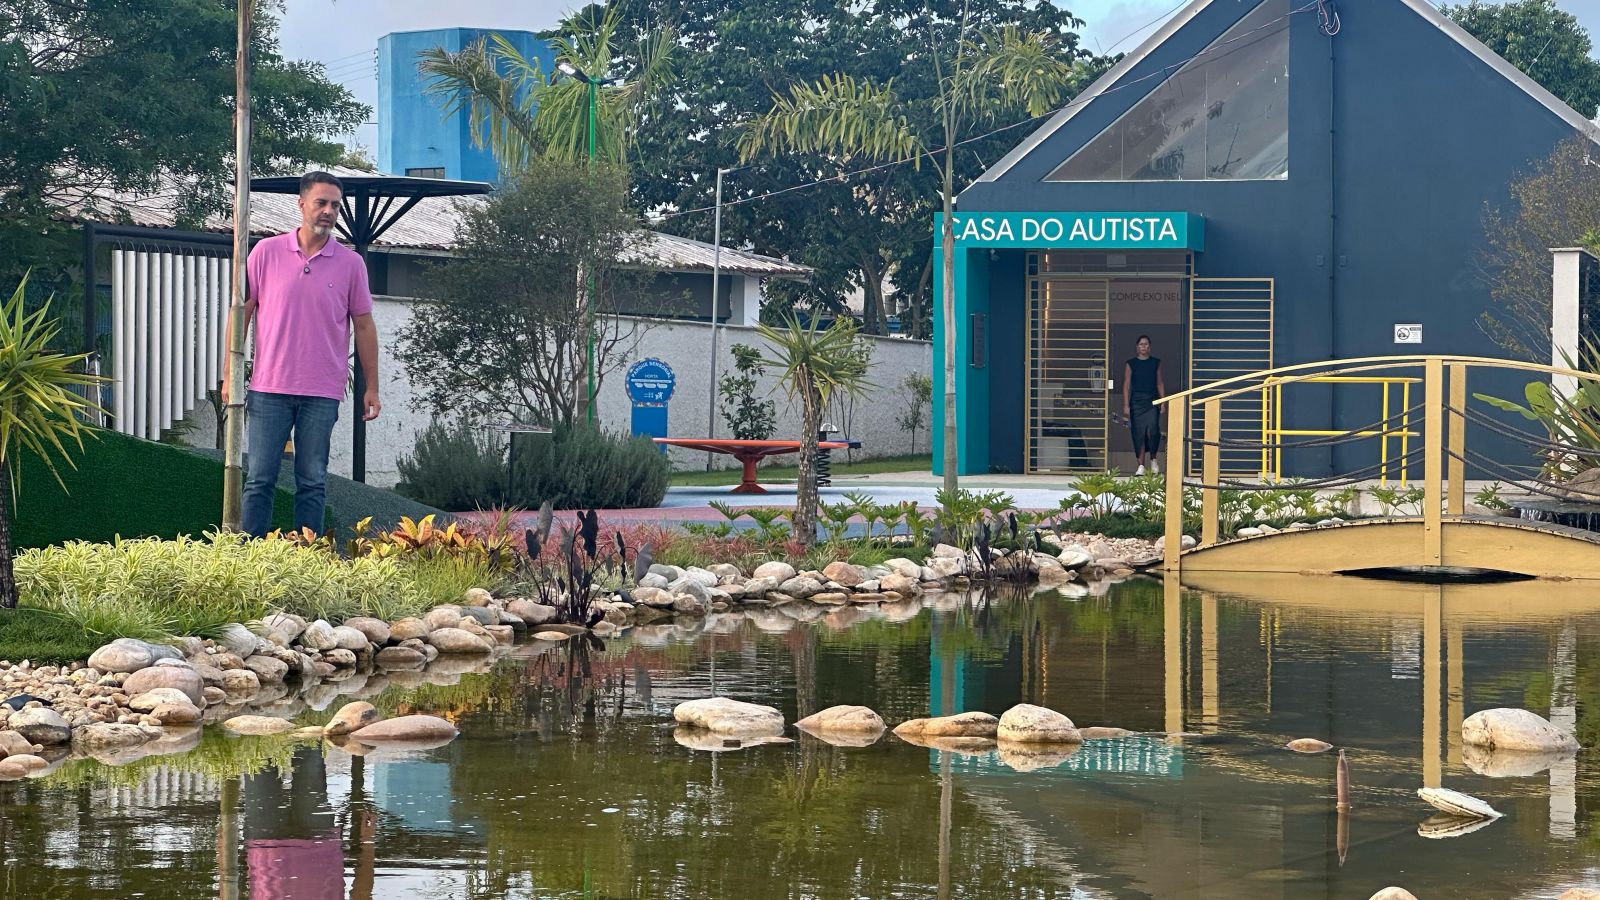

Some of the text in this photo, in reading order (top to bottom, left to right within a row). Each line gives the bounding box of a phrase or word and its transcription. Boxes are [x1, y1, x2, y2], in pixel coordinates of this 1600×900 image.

[1022, 218, 1063, 241] DO
[1069, 218, 1178, 241] AUTISTA
[1109, 292, 1162, 301] COMPLEXO
